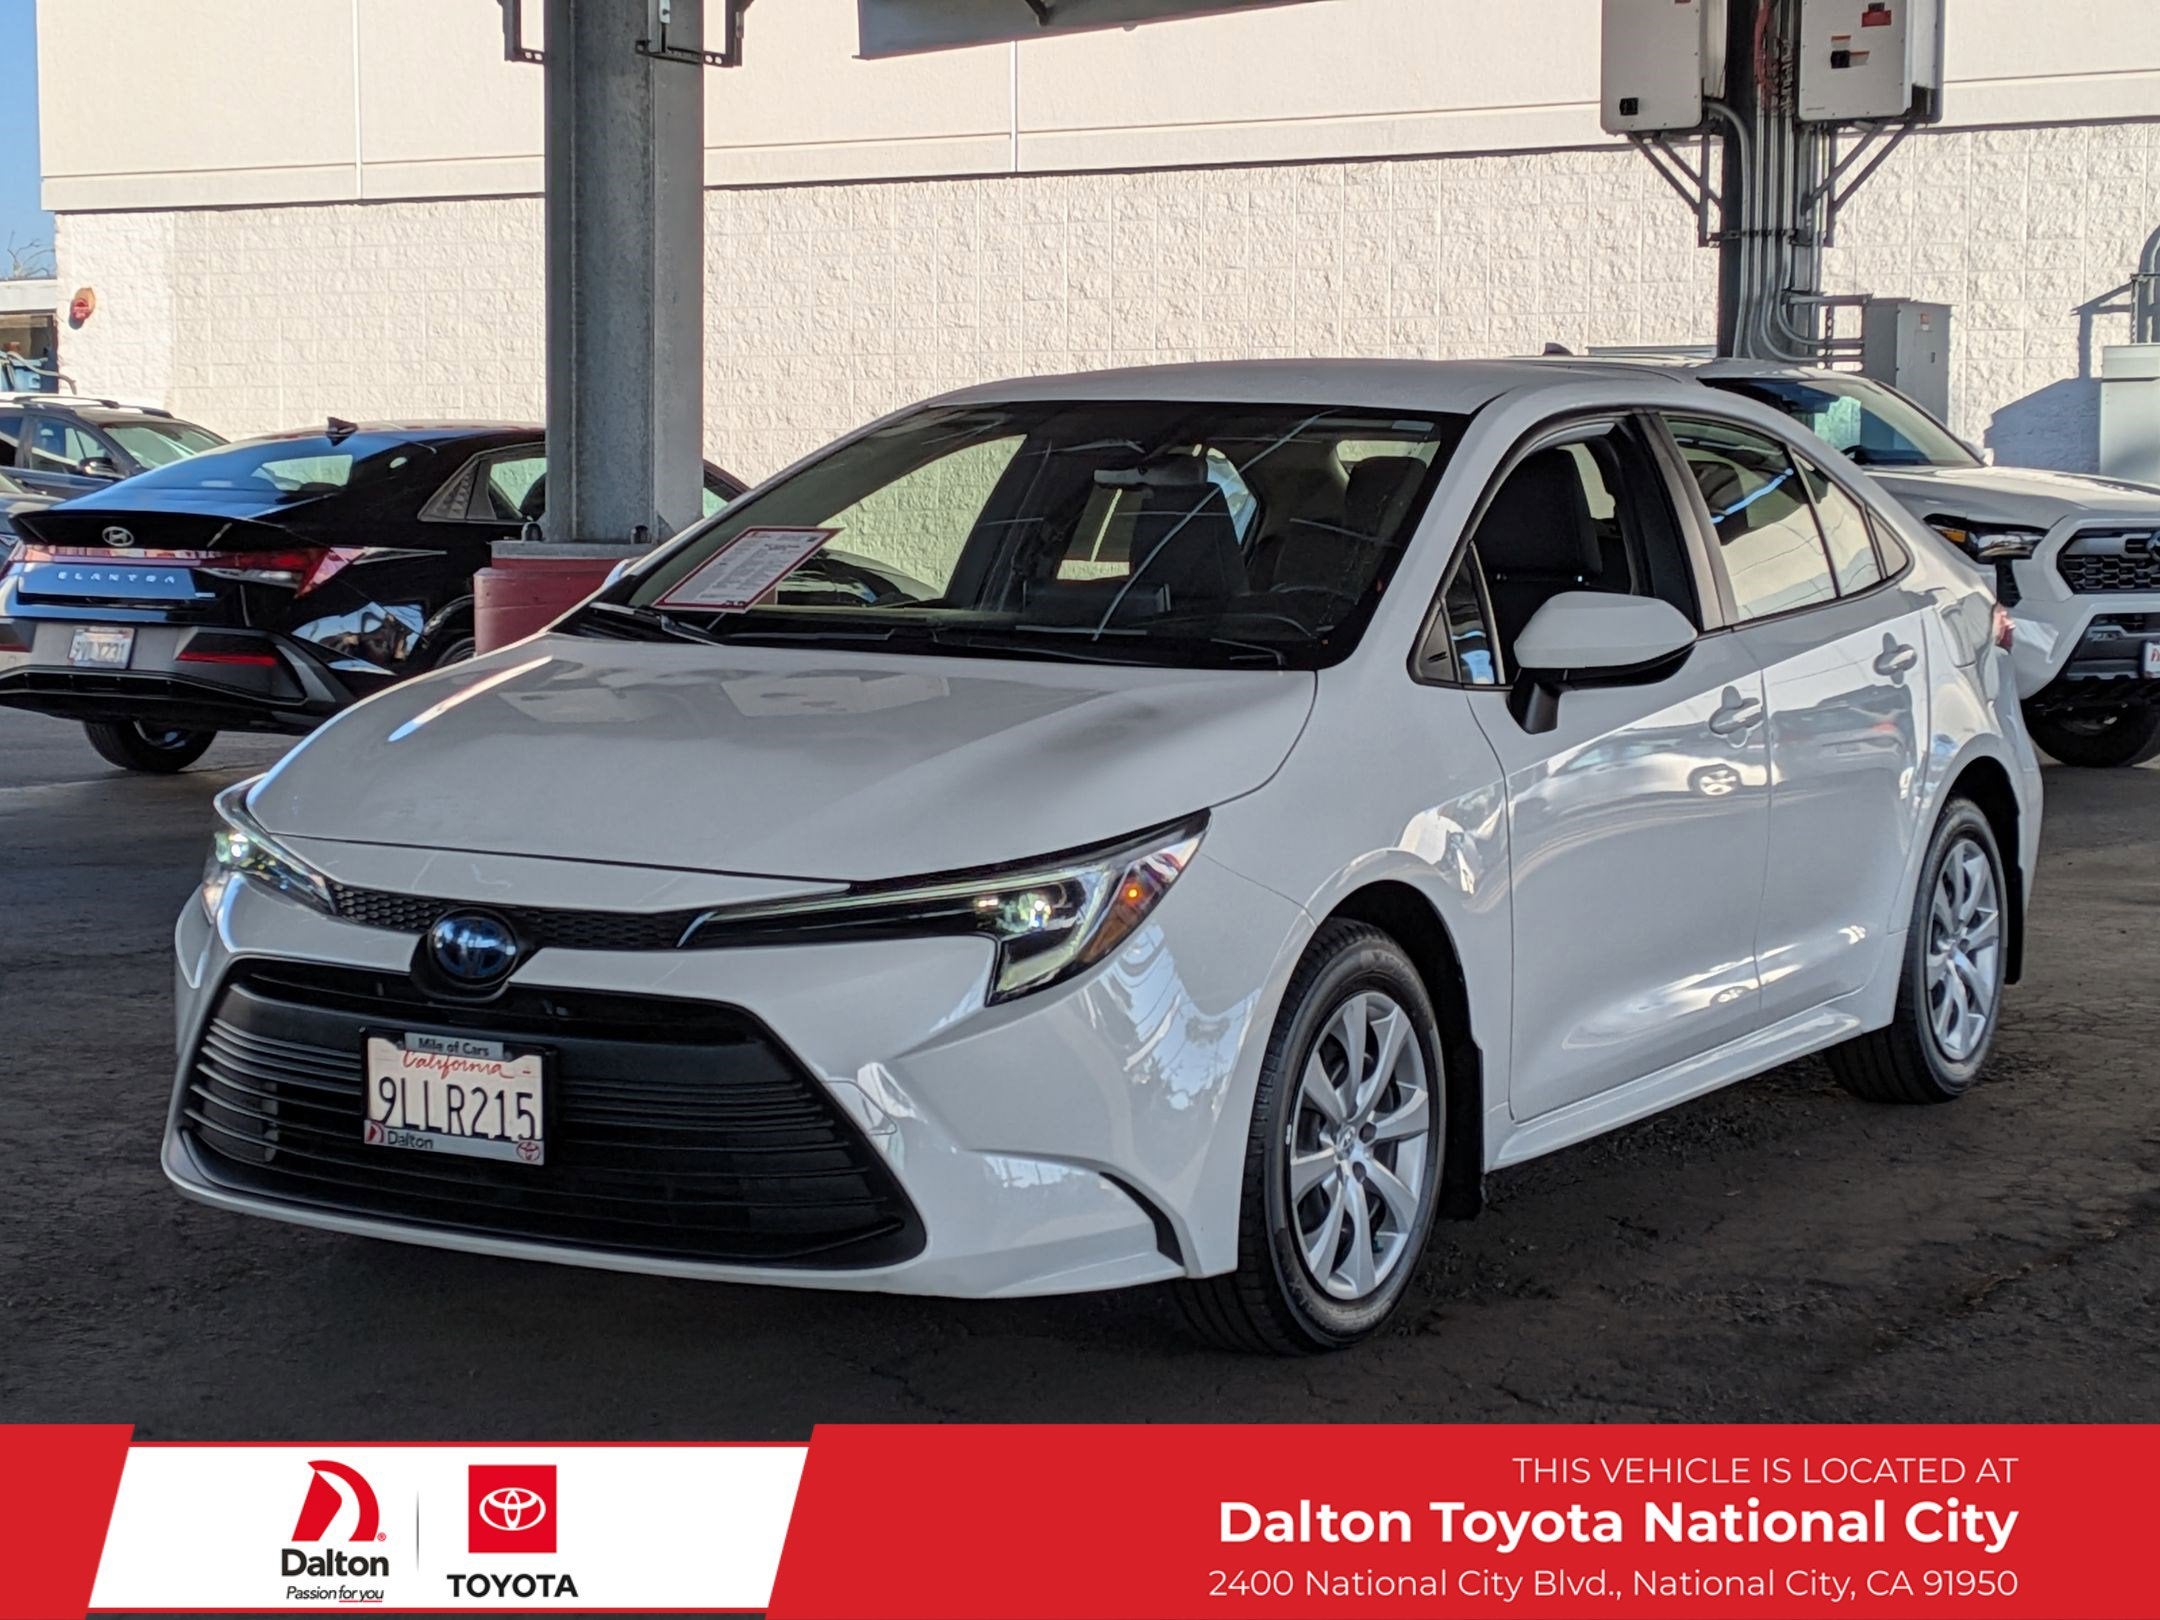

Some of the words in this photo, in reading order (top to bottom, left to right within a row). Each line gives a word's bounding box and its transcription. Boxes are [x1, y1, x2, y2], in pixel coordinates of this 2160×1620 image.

[418, 1037, 444, 1051] Mile
[445, 1040, 459, 1053] of
[462, 1043, 490, 1057] Cars
[402, 1049, 515, 1079] California
[379, 1076, 536, 1142] 9LLR215
[387, 1130, 434, 1149] Dalton
